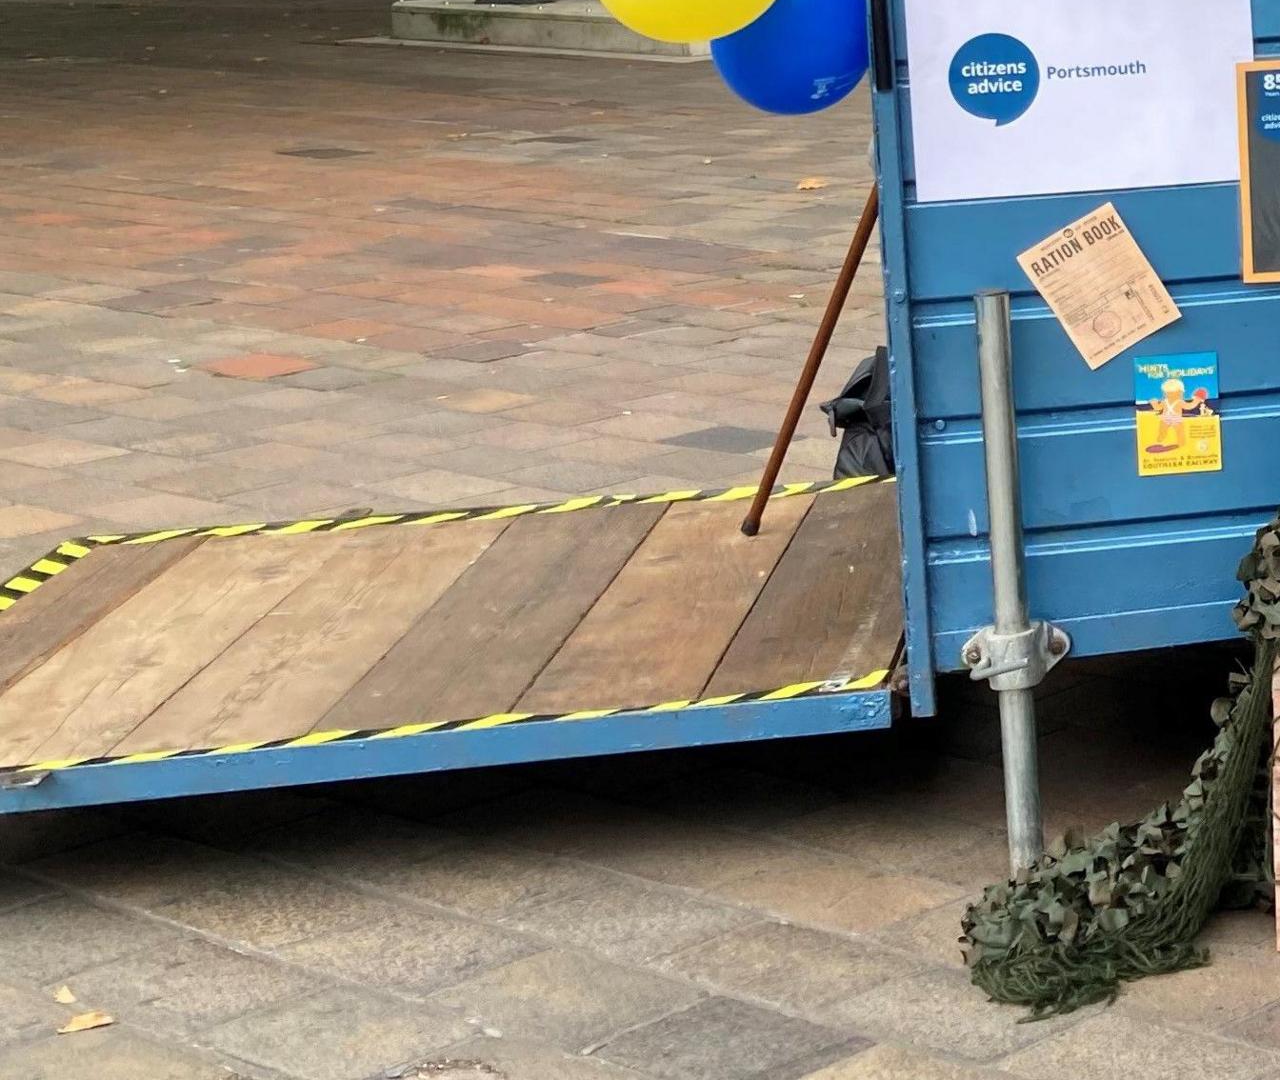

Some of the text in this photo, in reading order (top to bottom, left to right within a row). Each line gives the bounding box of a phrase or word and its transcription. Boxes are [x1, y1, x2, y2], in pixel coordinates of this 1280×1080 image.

[962, 61, 1026, 77] citizens
[1047, 60, 1147, 79] Portsmouth
[968, 78, 1022, 94] advice
[1031, 238, 1083, 277] RATION
[1082, 214, 1121, 246] BOOK
